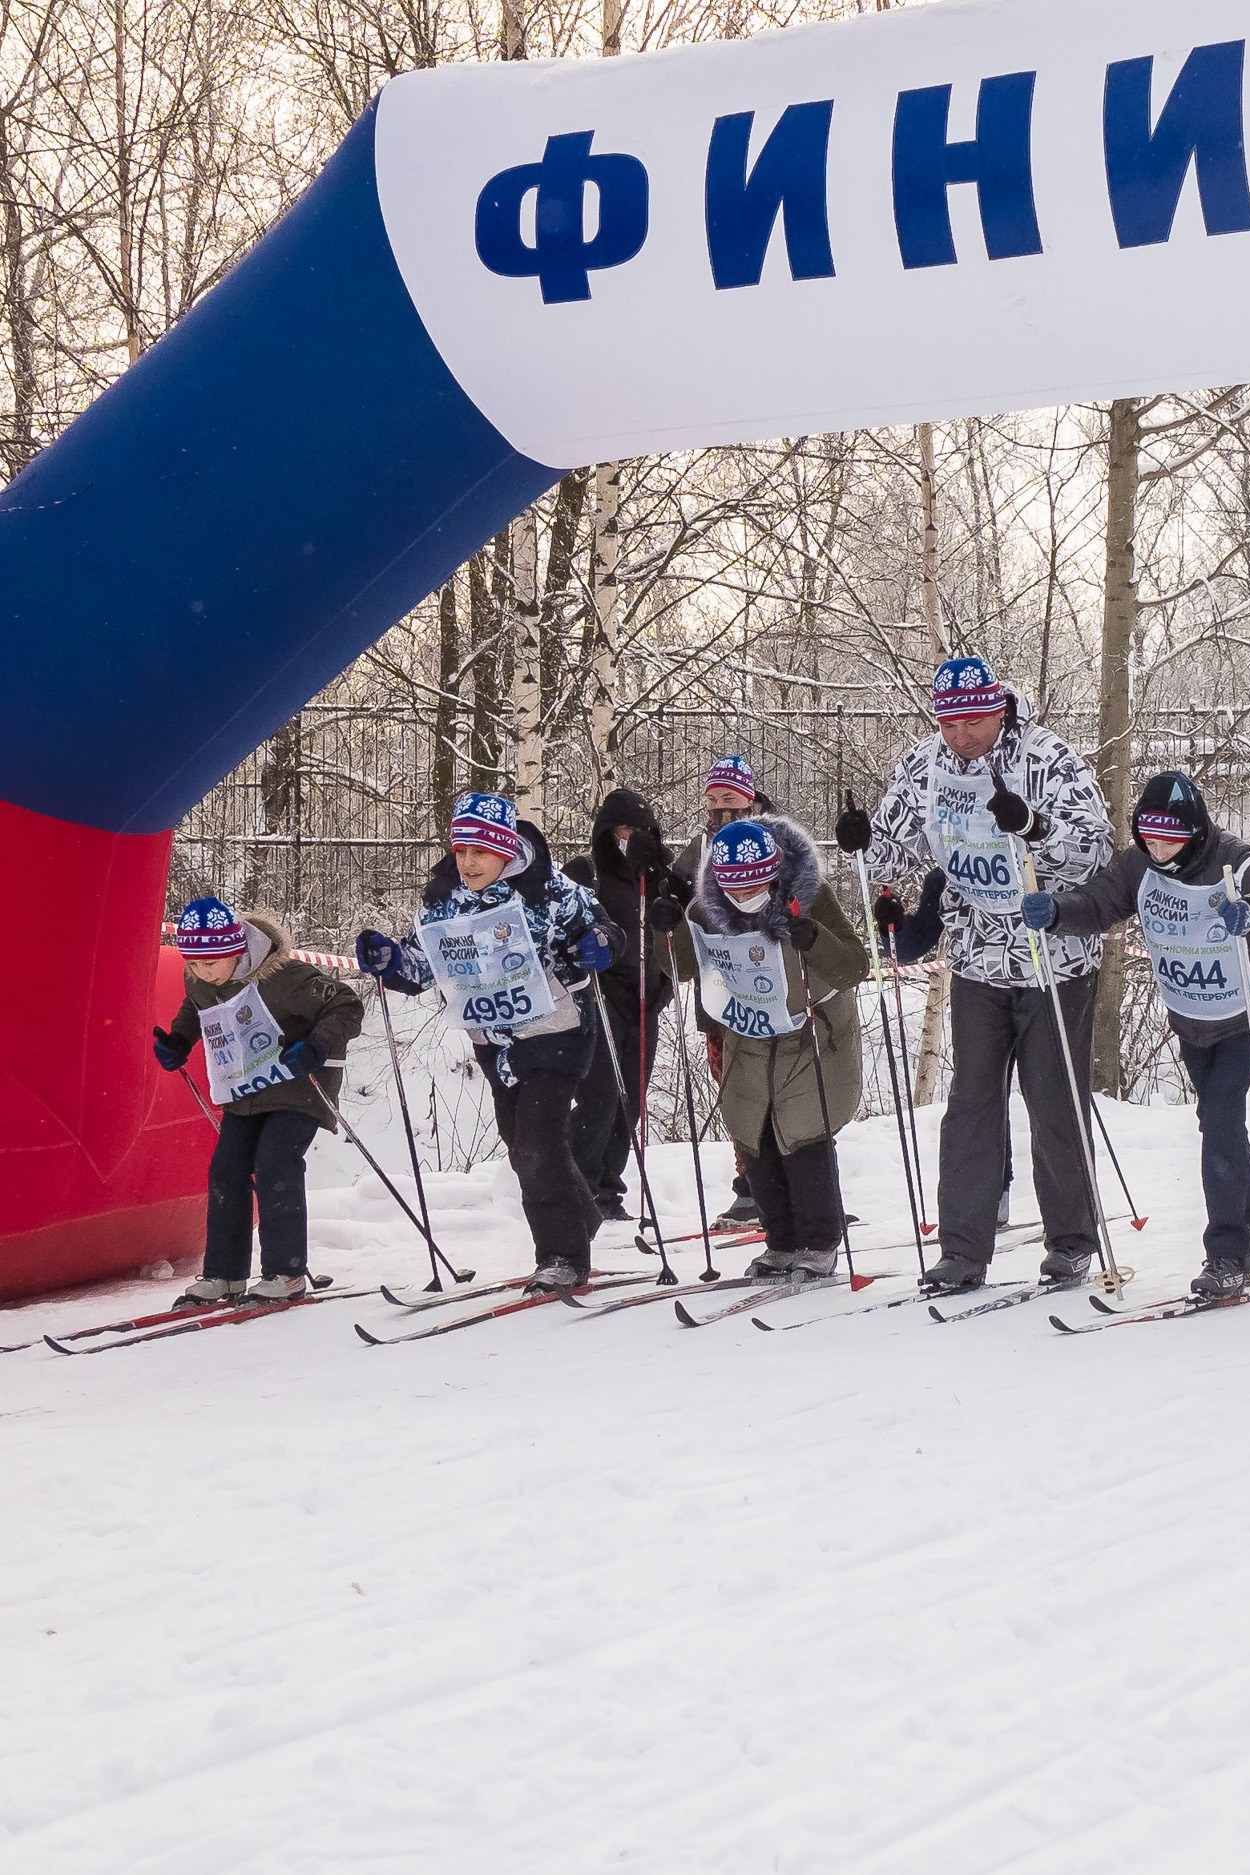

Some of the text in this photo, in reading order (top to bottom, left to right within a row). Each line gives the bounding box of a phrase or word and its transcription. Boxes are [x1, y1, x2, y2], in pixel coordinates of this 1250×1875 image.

[948, 850, 1010, 885] 4406
[1144, 900, 1189, 922] РОССИИ
[1147, 888, 1188, 912] ЛЫЖНЯ
[1144, 915, 1187, 936] 2021
[442, 947, 480, 961] РОССИИ
[1158, 956, 1228, 990] 4644
[463, 985, 532, 1014] 4955
[722, 996, 775, 1036] 4928
